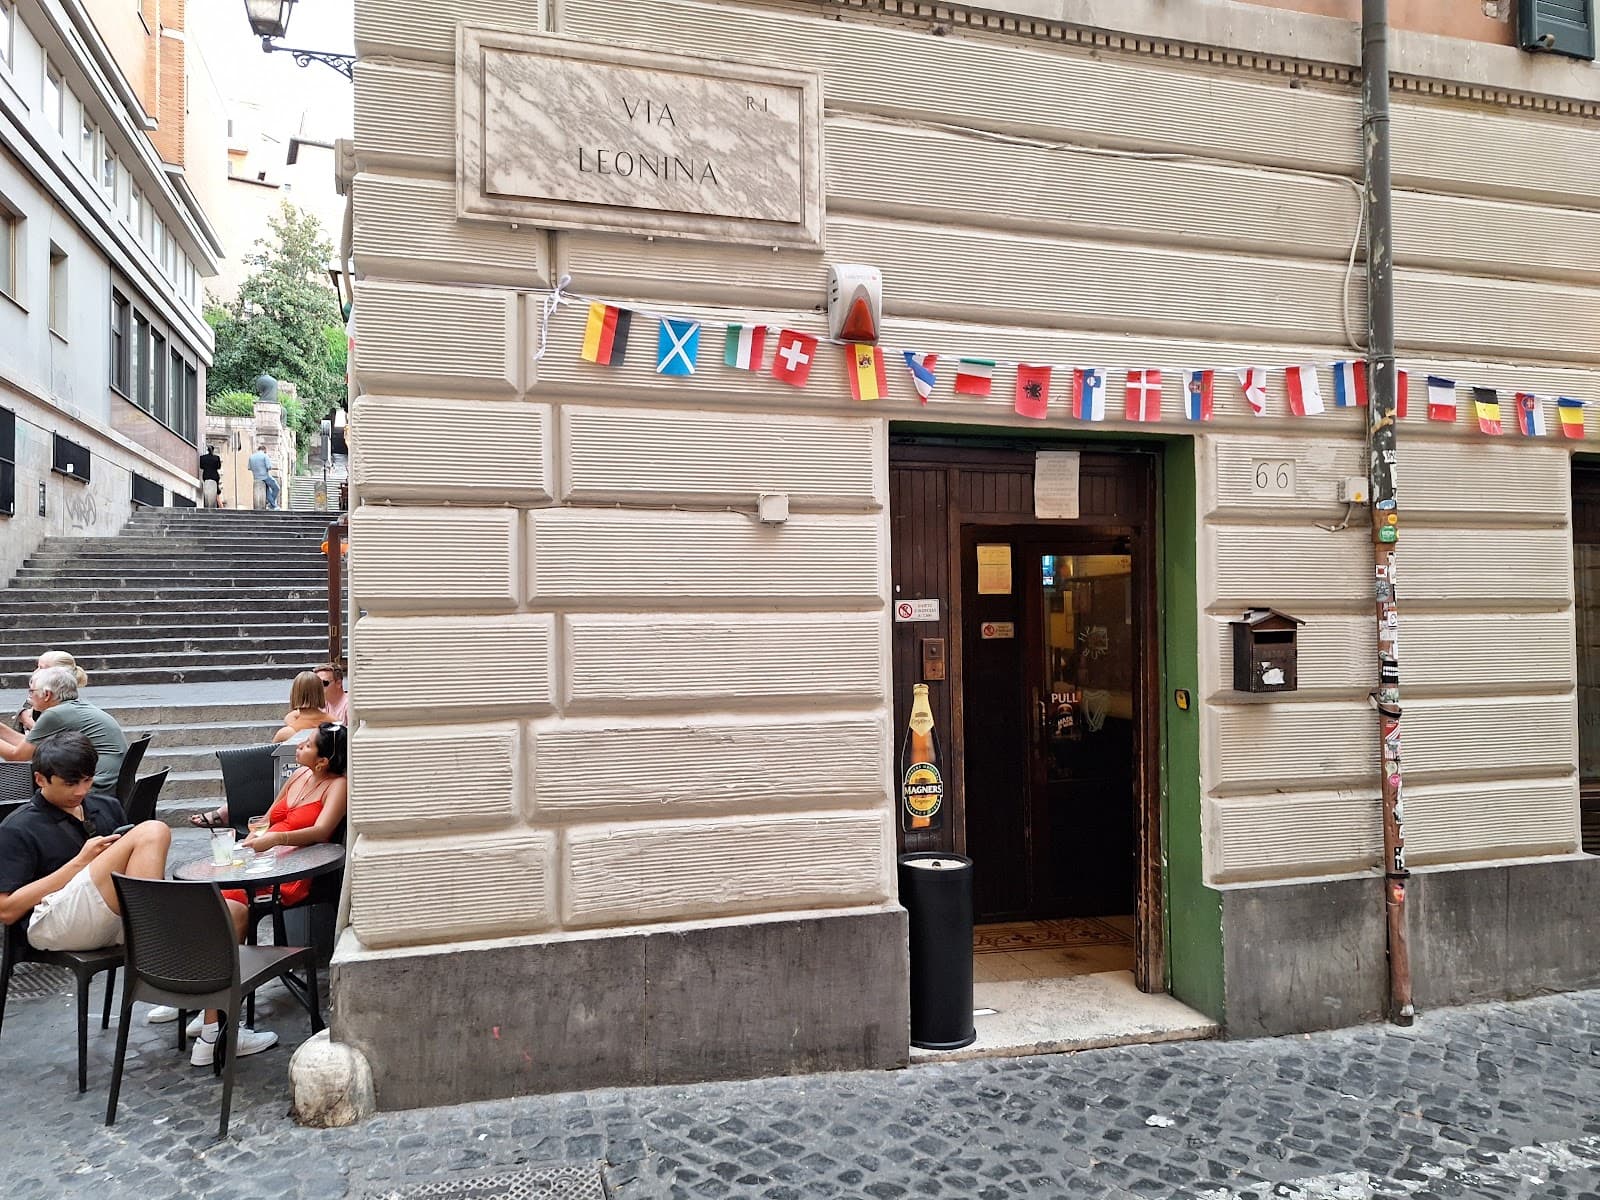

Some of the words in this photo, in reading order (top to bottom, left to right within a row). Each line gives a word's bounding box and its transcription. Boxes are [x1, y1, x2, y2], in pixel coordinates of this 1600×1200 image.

[622, 97, 676, 126] VIA
[578, 147, 718, 185] LEONINA
[1256, 462, 1289, 489] 66
[1051, 692, 1079, 703] PULL
[904, 784, 942, 795] MAGNERS
